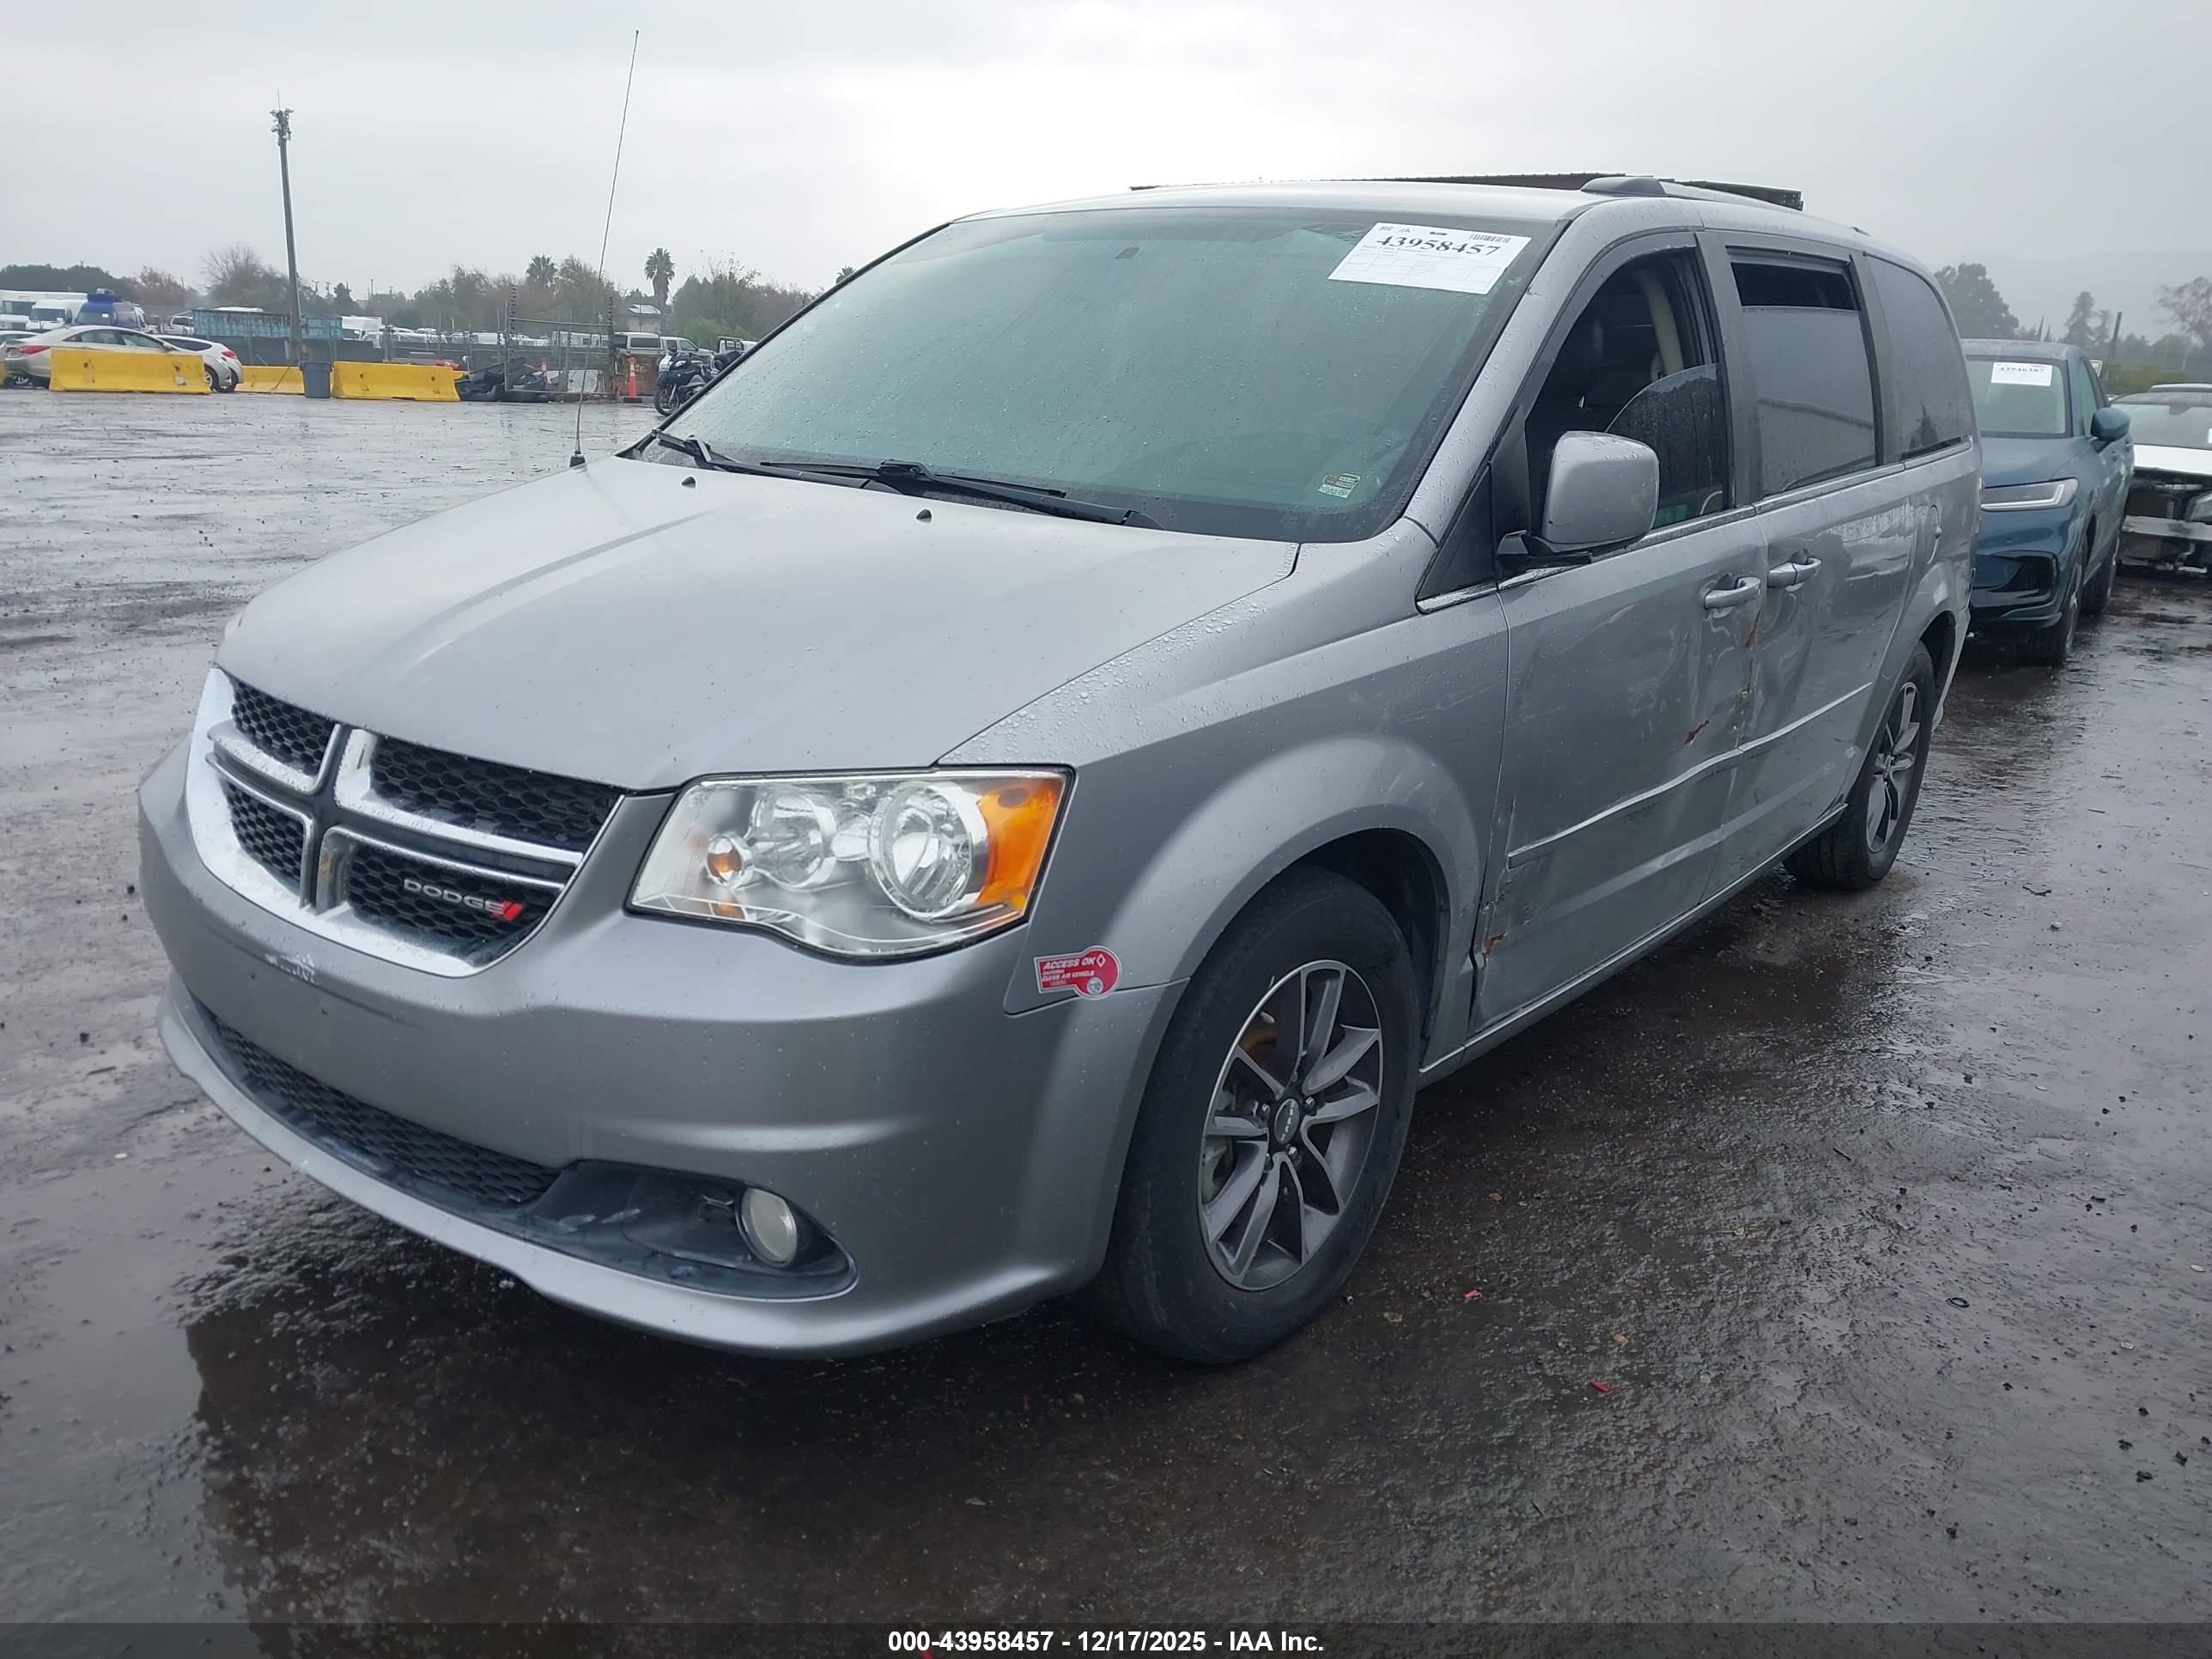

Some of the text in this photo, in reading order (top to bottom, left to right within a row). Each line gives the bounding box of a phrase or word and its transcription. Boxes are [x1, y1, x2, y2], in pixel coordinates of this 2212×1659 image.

[1376, 235, 1501, 256] 43958457
[404, 878, 505, 915] DODGE
[1043, 957, 1097, 969] ACCESS OK
[1042, 974, 1060, 982] CLEAN
